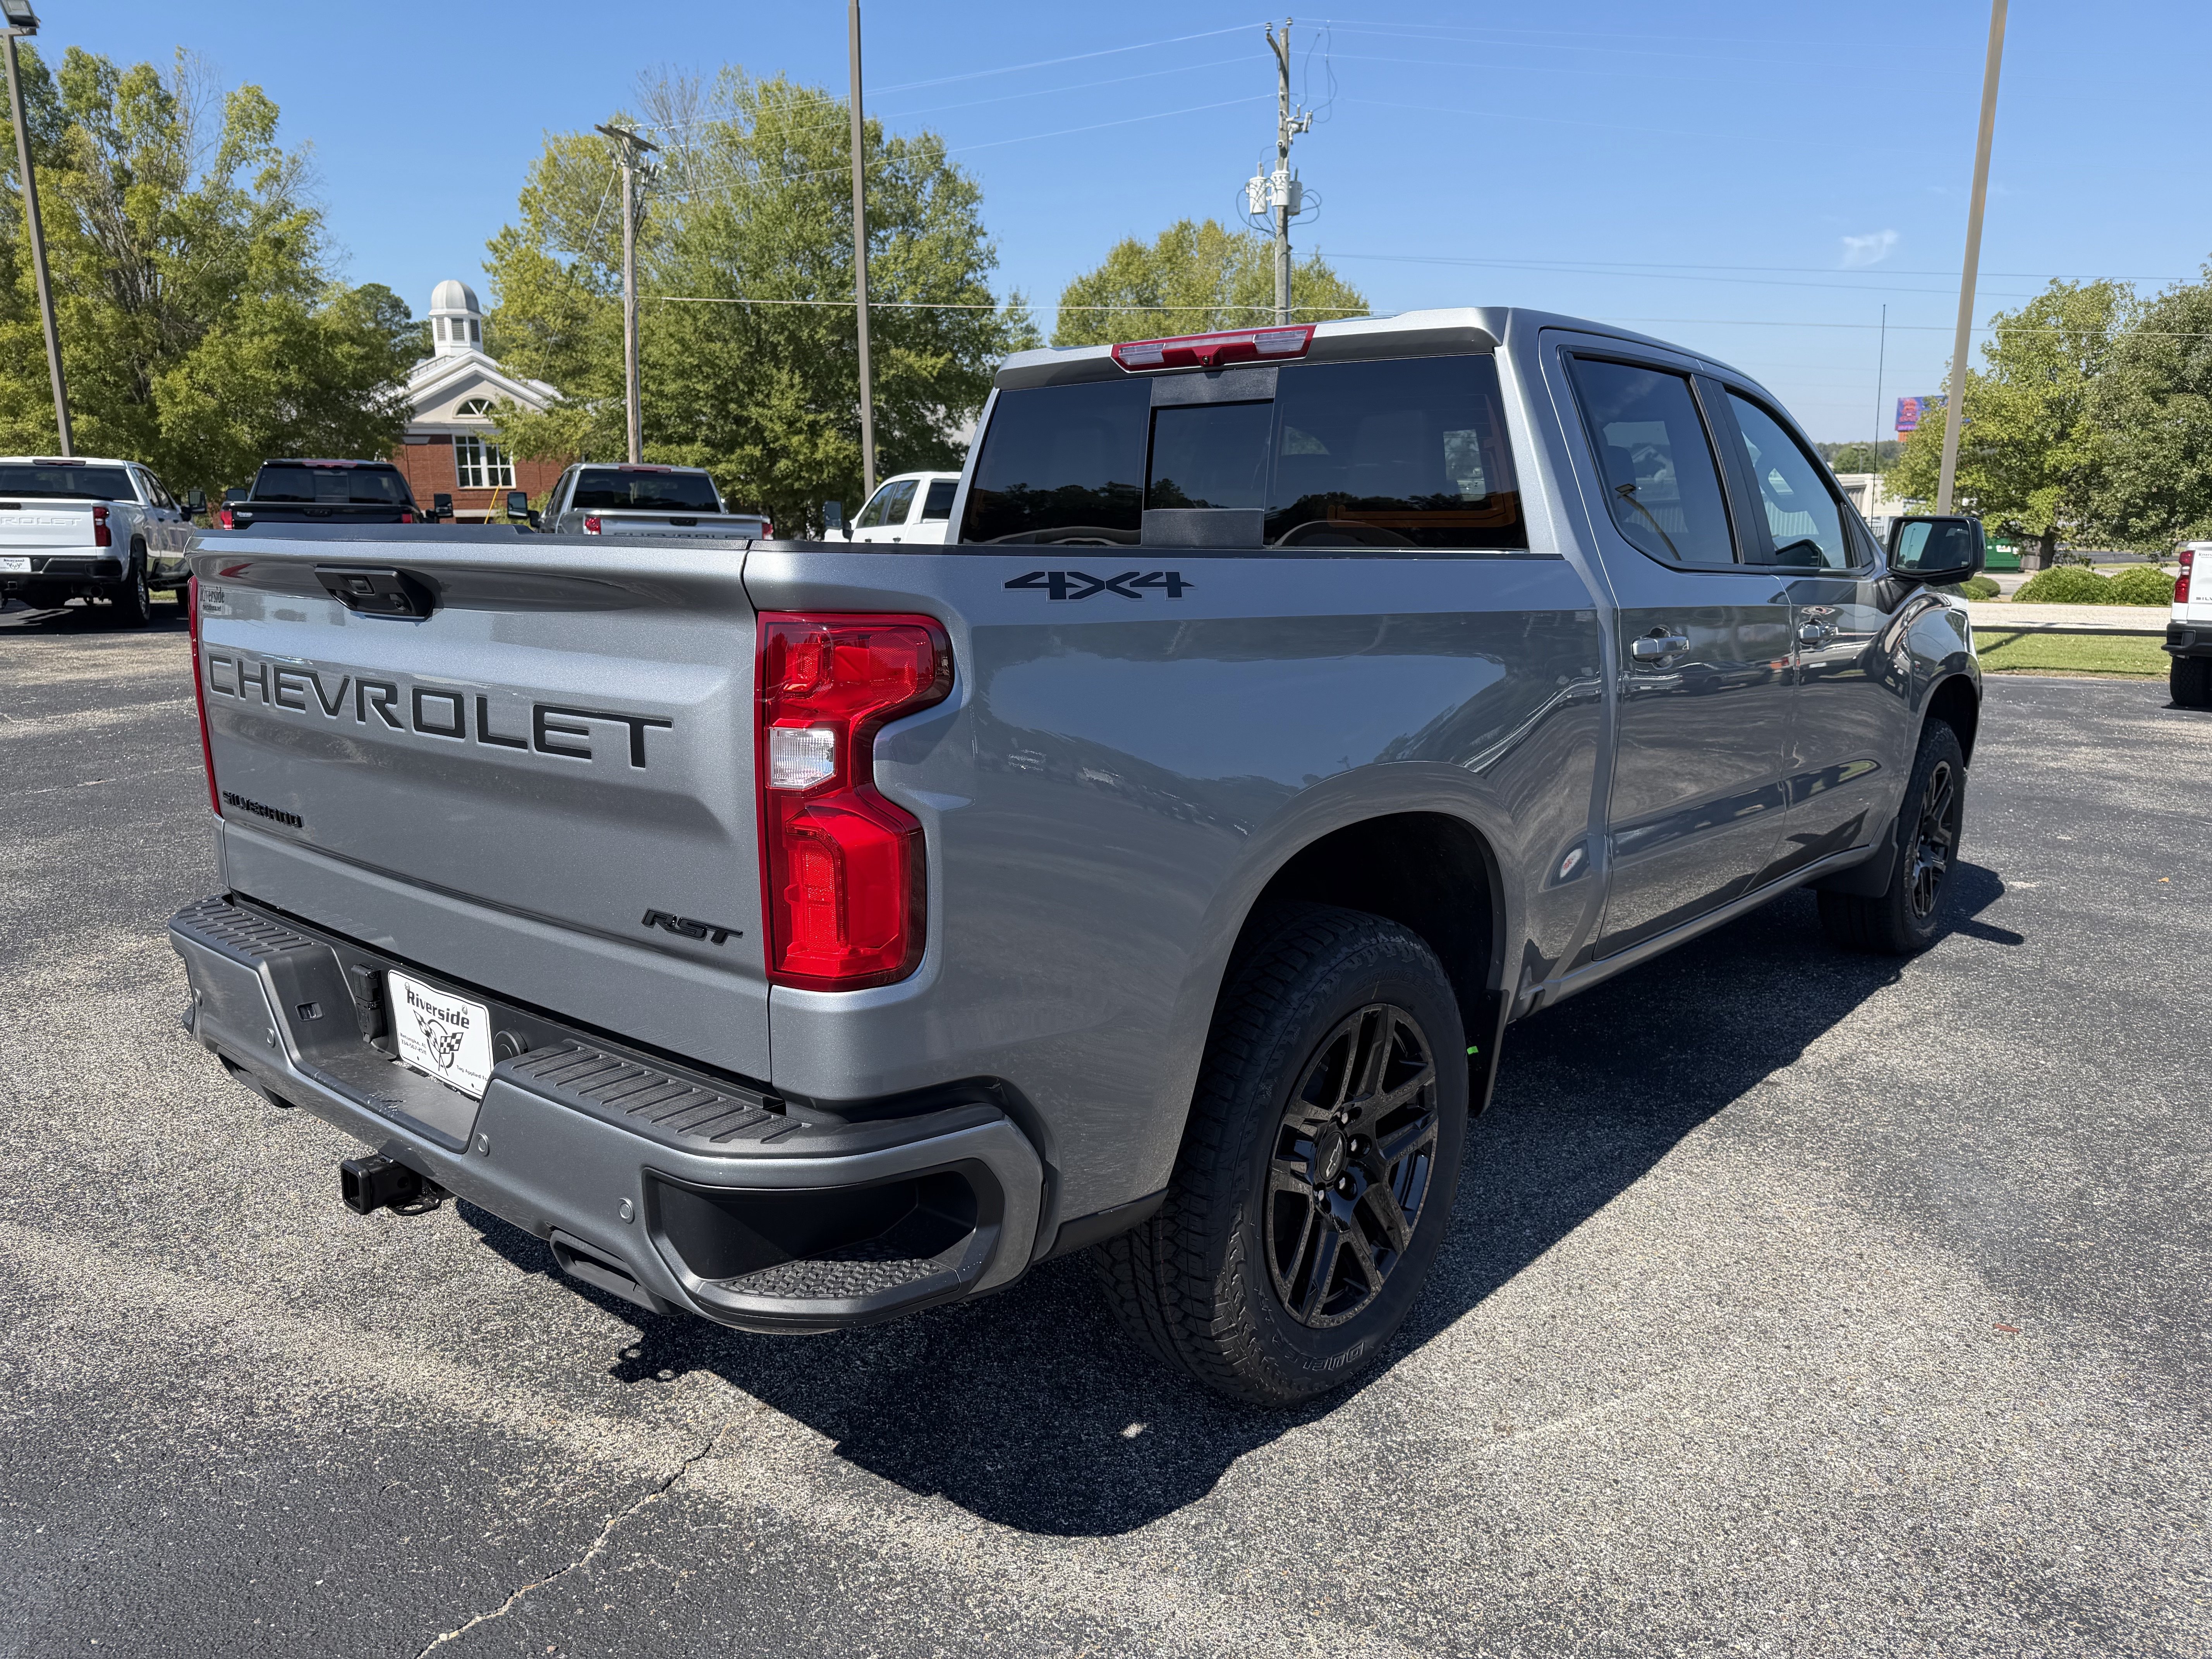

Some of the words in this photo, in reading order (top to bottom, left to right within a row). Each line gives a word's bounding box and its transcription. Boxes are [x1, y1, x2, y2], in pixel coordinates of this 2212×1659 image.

[200, 585, 225, 603] Riverside
[1004, 571, 1195, 600] 4X4
[208, 654, 673, 769] CHEVROLET
[222, 790, 304, 828] SILVERADO
[641, 908, 744, 946] RST
[407, 990, 469, 1029] Riverside
